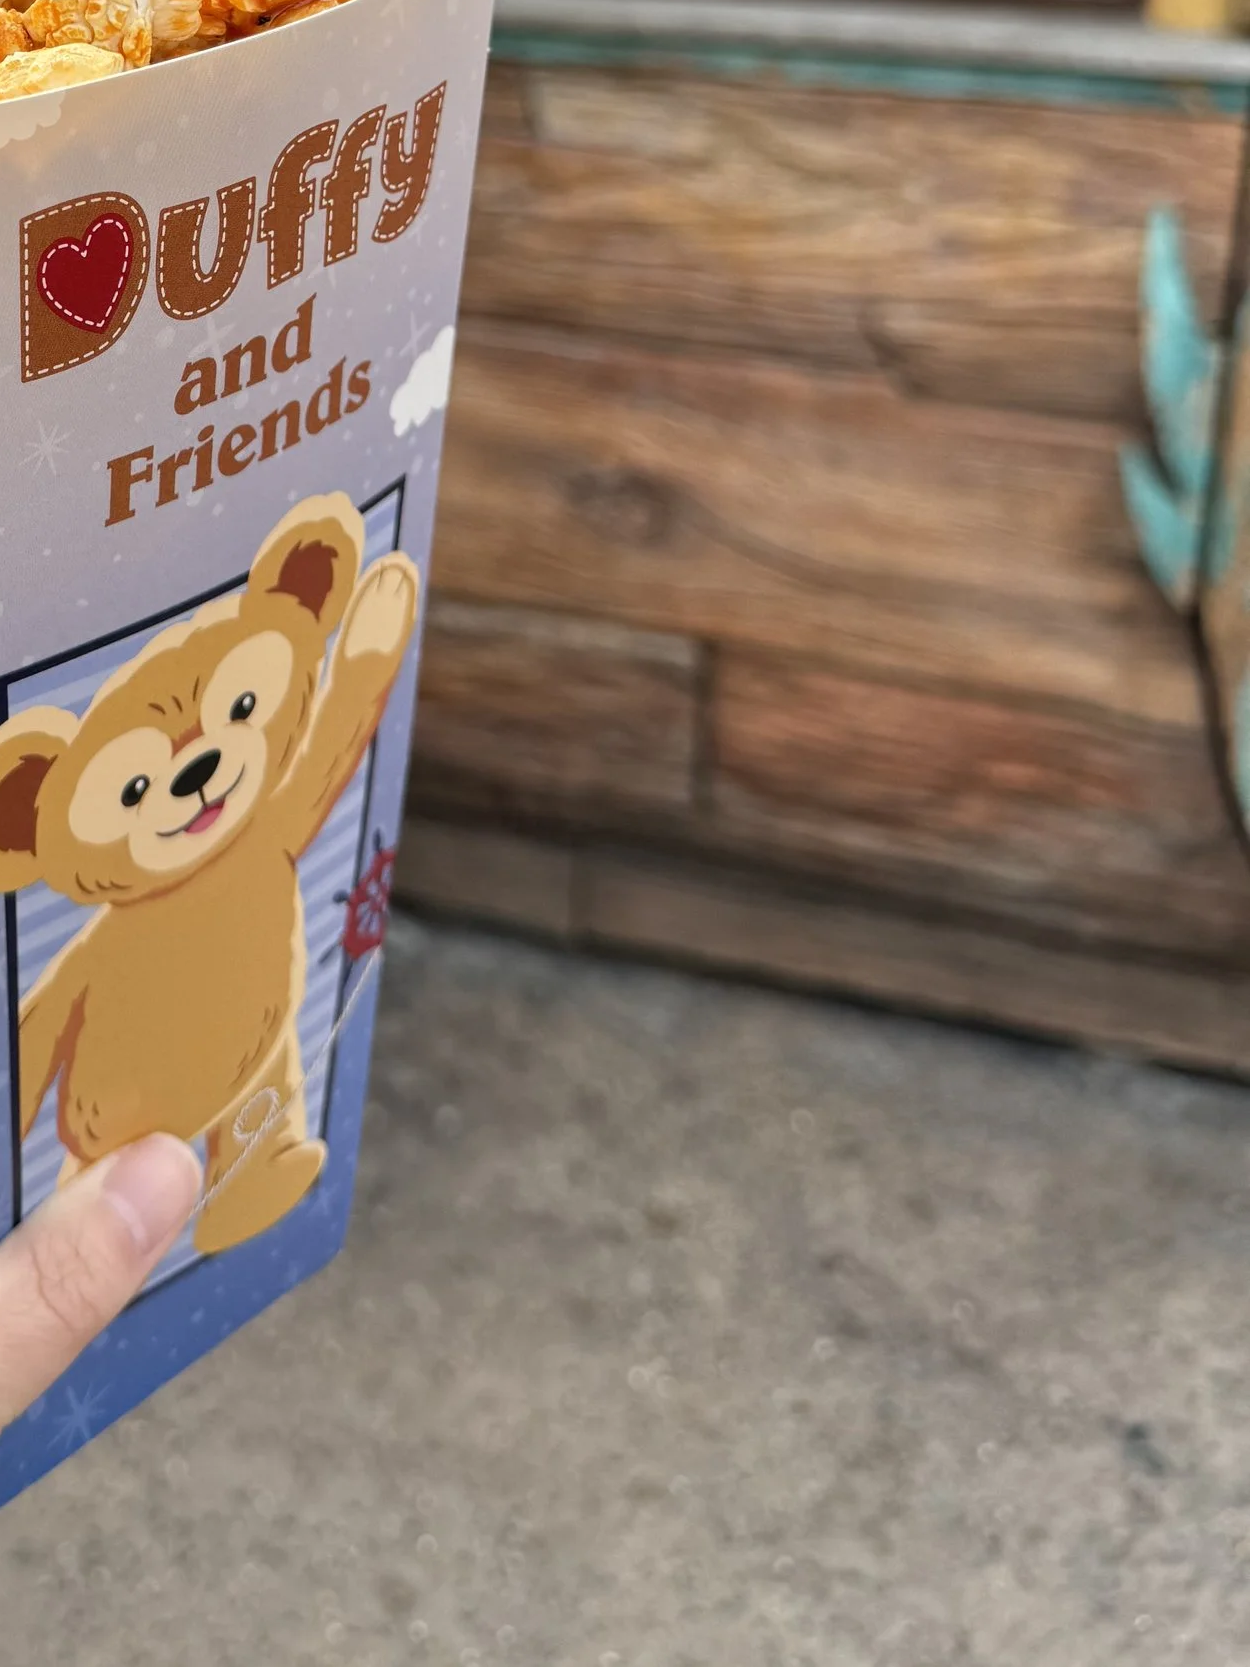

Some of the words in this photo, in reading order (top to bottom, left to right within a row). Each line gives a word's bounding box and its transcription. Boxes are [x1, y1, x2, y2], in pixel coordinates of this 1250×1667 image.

[19, 80, 447, 383] Duffy
[173, 292, 317, 416] and
[104, 355, 372, 528] Friends
